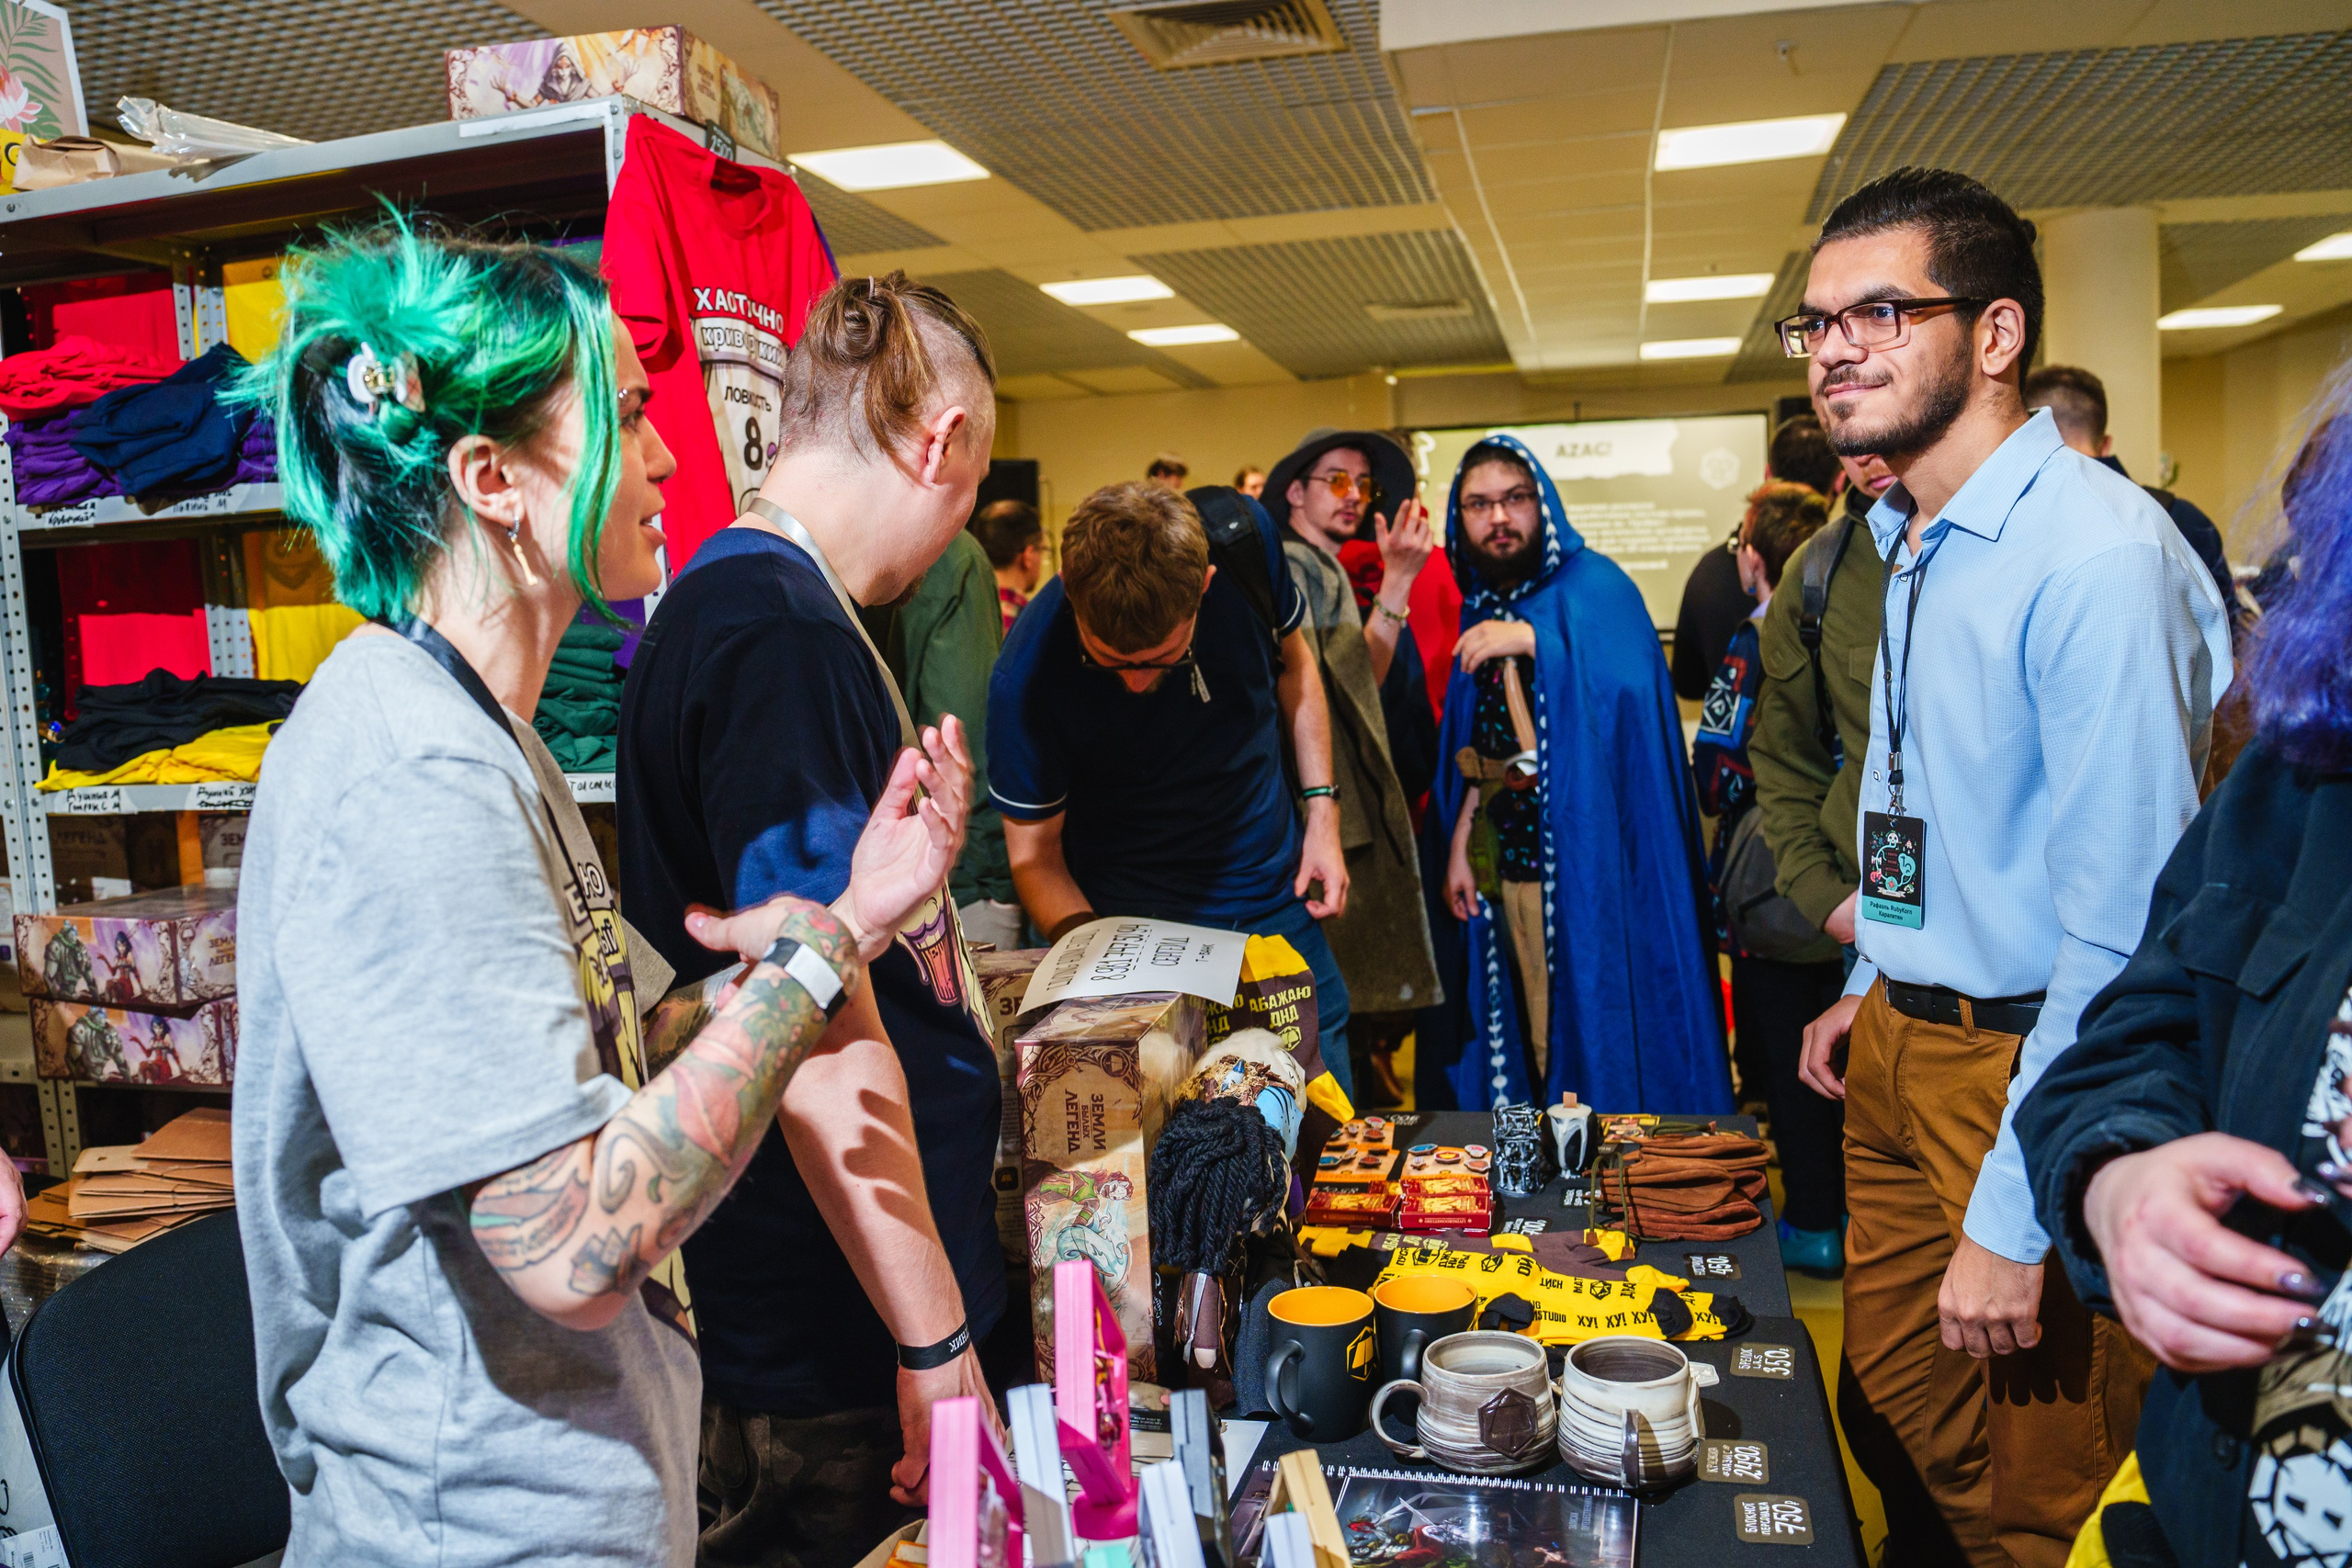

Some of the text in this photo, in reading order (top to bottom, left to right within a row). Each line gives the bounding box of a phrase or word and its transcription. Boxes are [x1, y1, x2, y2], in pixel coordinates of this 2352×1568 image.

[743, 416, 763, 470] 8
[1249, 985, 1312, 1013] АБАЖАЮ
[1269, 1004, 1299, 1029] ДНД
[1064, 1088, 1081, 1155] ЛЕГЕНД
[1080, 1104, 1091, 1139] БЫЛЫХ
[1091, 1093, 1107, 1150] ЗЕМЛИ
[1517, 1257, 1534, 1277] ОЙ
[1741, 1501, 1758, 1534] БЛОКНОТ
